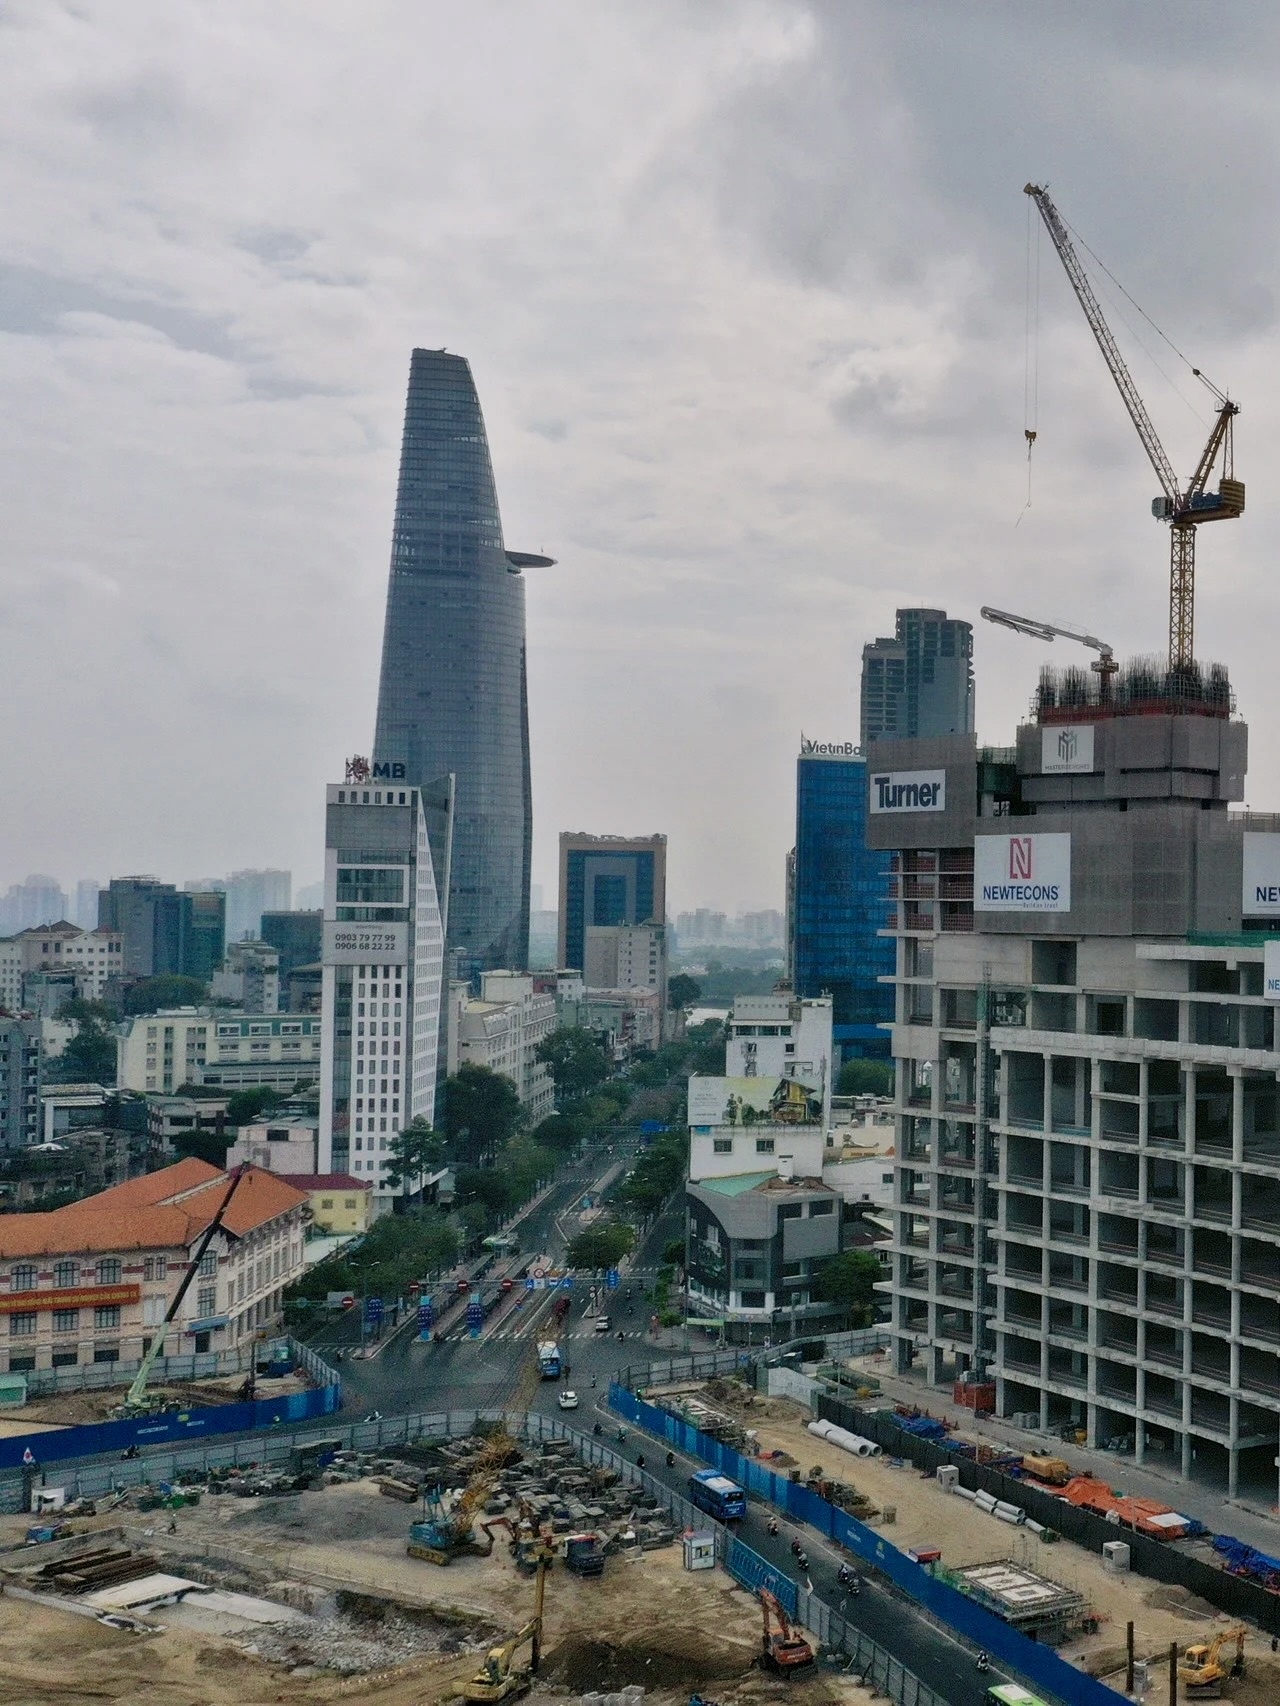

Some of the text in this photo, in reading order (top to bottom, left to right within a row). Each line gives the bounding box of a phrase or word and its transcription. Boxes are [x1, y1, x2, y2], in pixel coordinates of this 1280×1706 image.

[372, 762, 406, 779] MB
[874, 776, 941, 809] Turner
[983, 885, 1059, 901] NEWTECONS
[335, 933, 357, 941] 0903
[372, 934, 383, 942] 77
[384, 934, 396, 942] 99
[335, 942, 357, 950] 0906
[359, 942, 370, 950] 68
[384, 943, 396, 951] 22
